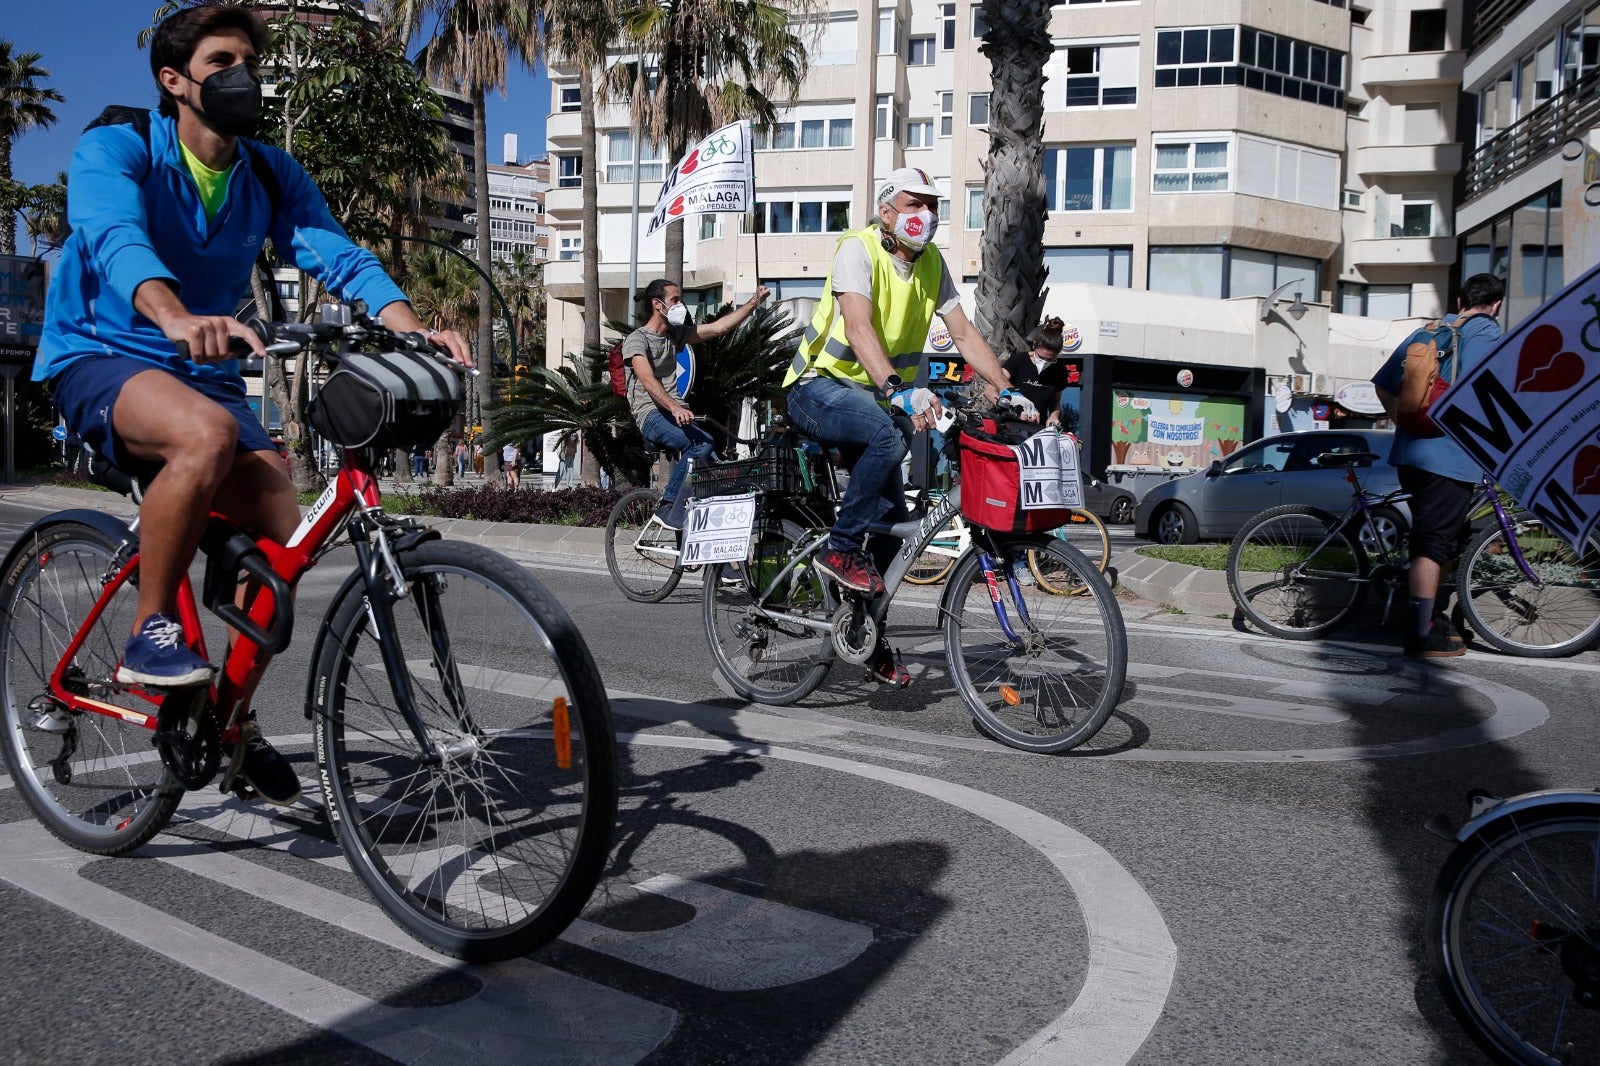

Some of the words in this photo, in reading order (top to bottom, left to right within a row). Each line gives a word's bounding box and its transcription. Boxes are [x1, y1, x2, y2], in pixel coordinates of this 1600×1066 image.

[931, 333, 951, 344] KING
[1064, 332, 1079, 341] ING
[928, 361, 976, 382] PLA
[1169, 423, 1175, 431] TU
[1439, 368, 1534, 473] M
[1153, 429, 1165, 439] CON
[1166, 431, 1200, 441] NOSOTROS!
[1019, 438, 1046, 466] M
[1025, 482, 1043, 504] M
[306, 487, 334, 524] btwin
[1532, 477, 1588, 543] M
[692, 507, 709, 531] M
[686, 543, 700, 560] M
